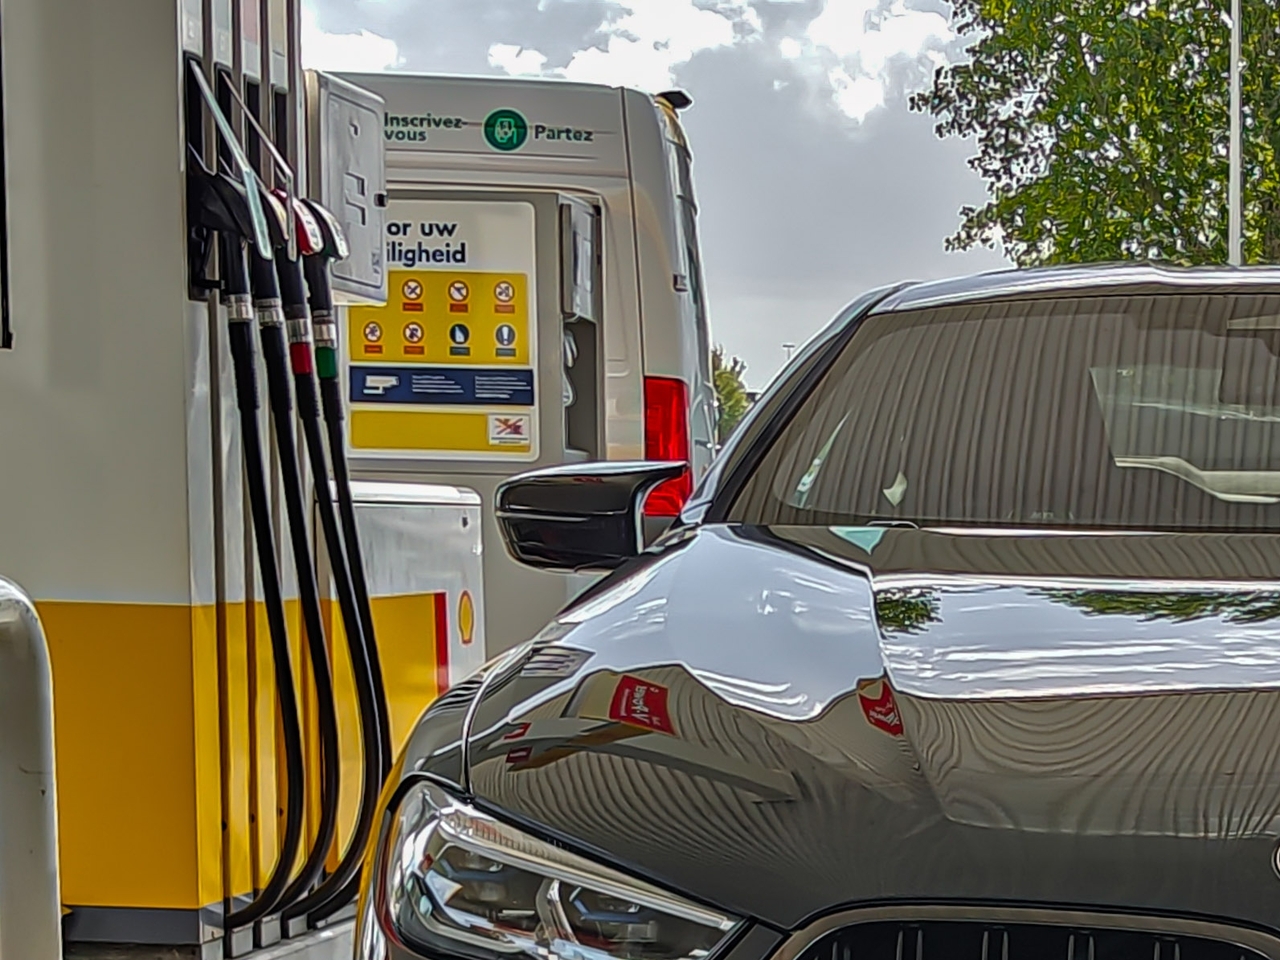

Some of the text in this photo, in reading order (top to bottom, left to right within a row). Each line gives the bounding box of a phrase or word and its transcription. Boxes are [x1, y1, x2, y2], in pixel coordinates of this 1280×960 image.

[384, 129, 427, 142] vous
[534, 124, 594, 142] Partez
[420, 223, 457, 237] uw
